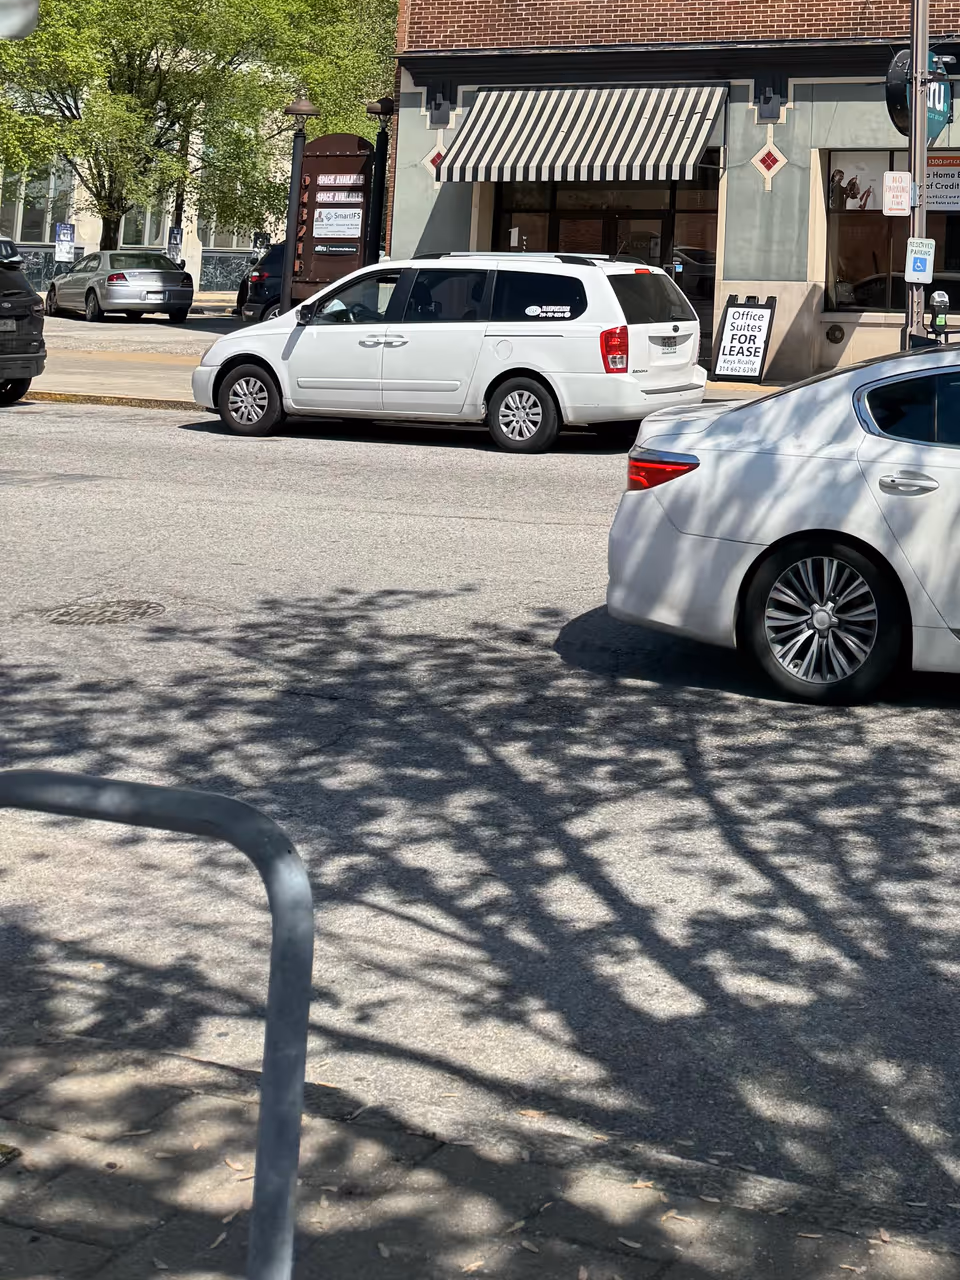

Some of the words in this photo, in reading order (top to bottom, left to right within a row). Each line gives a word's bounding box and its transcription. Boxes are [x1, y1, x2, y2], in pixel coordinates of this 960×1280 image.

[317, 175, 334, 184] SPACE
[335, 175, 364, 184] AVAILABLE
[932, 171, 955, 179] Home
[892, 176, 903, 184] NO
[885, 185, 908, 193] PARKING
[935, 182, 959, 190] Credit
[316, 192, 334, 201] SPACE
[335, 192, 363, 202] AVAILABLE
[909, 241, 934, 249] RESERVED
[732, 310, 764, 322] Office
[730, 321, 762, 333] Suites
[730, 334, 757, 345] FOR
[722, 346, 761, 357] LEASE
[723, 358, 736, 366] Keys
[737, 358, 756, 367] Realty
